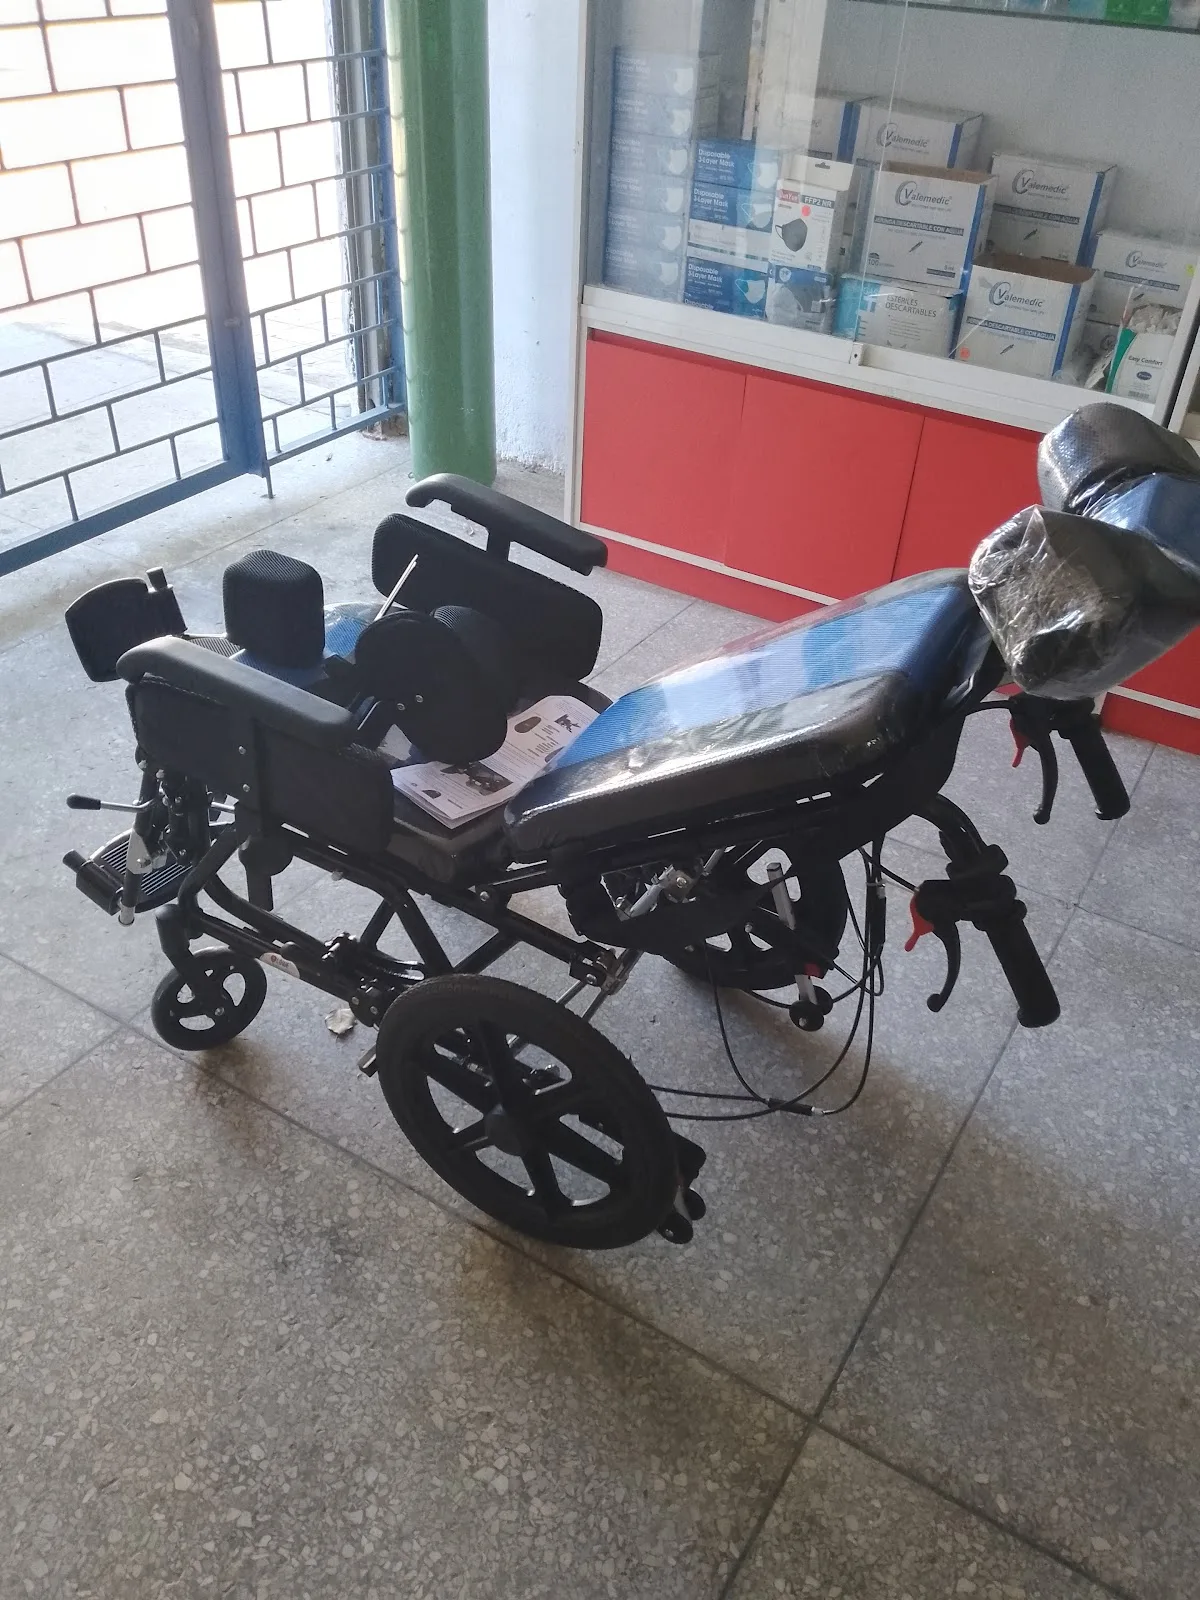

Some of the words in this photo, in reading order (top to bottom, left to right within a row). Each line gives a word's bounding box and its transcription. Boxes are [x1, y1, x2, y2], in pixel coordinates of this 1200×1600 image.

[699, 149, 731, 159] Disposable
[698, 156, 718, 165] 3-Layer
[720, 159, 734, 167] Mask
[1019, 174, 1067, 194] Valemedic
[694, 188, 724, 199] Disposable
[902, 186, 951, 206] Valemedic
[693, 196, 712, 204] 3-Layer
[714, 199, 728, 207] Mask
[804, 197, 820, 205] FFP2
[688, 264, 718, 275] Disposable
[688, 270, 706, 279] 3-Layer
[708, 274, 722, 283] Mask
[995, 286, 1044, 307] Valemedic
[885, 302, 937, 318] DESCARTABLES
[1128, 355, 1141, 364] Easy
[1142, 357, 1163, 367] Comfort
